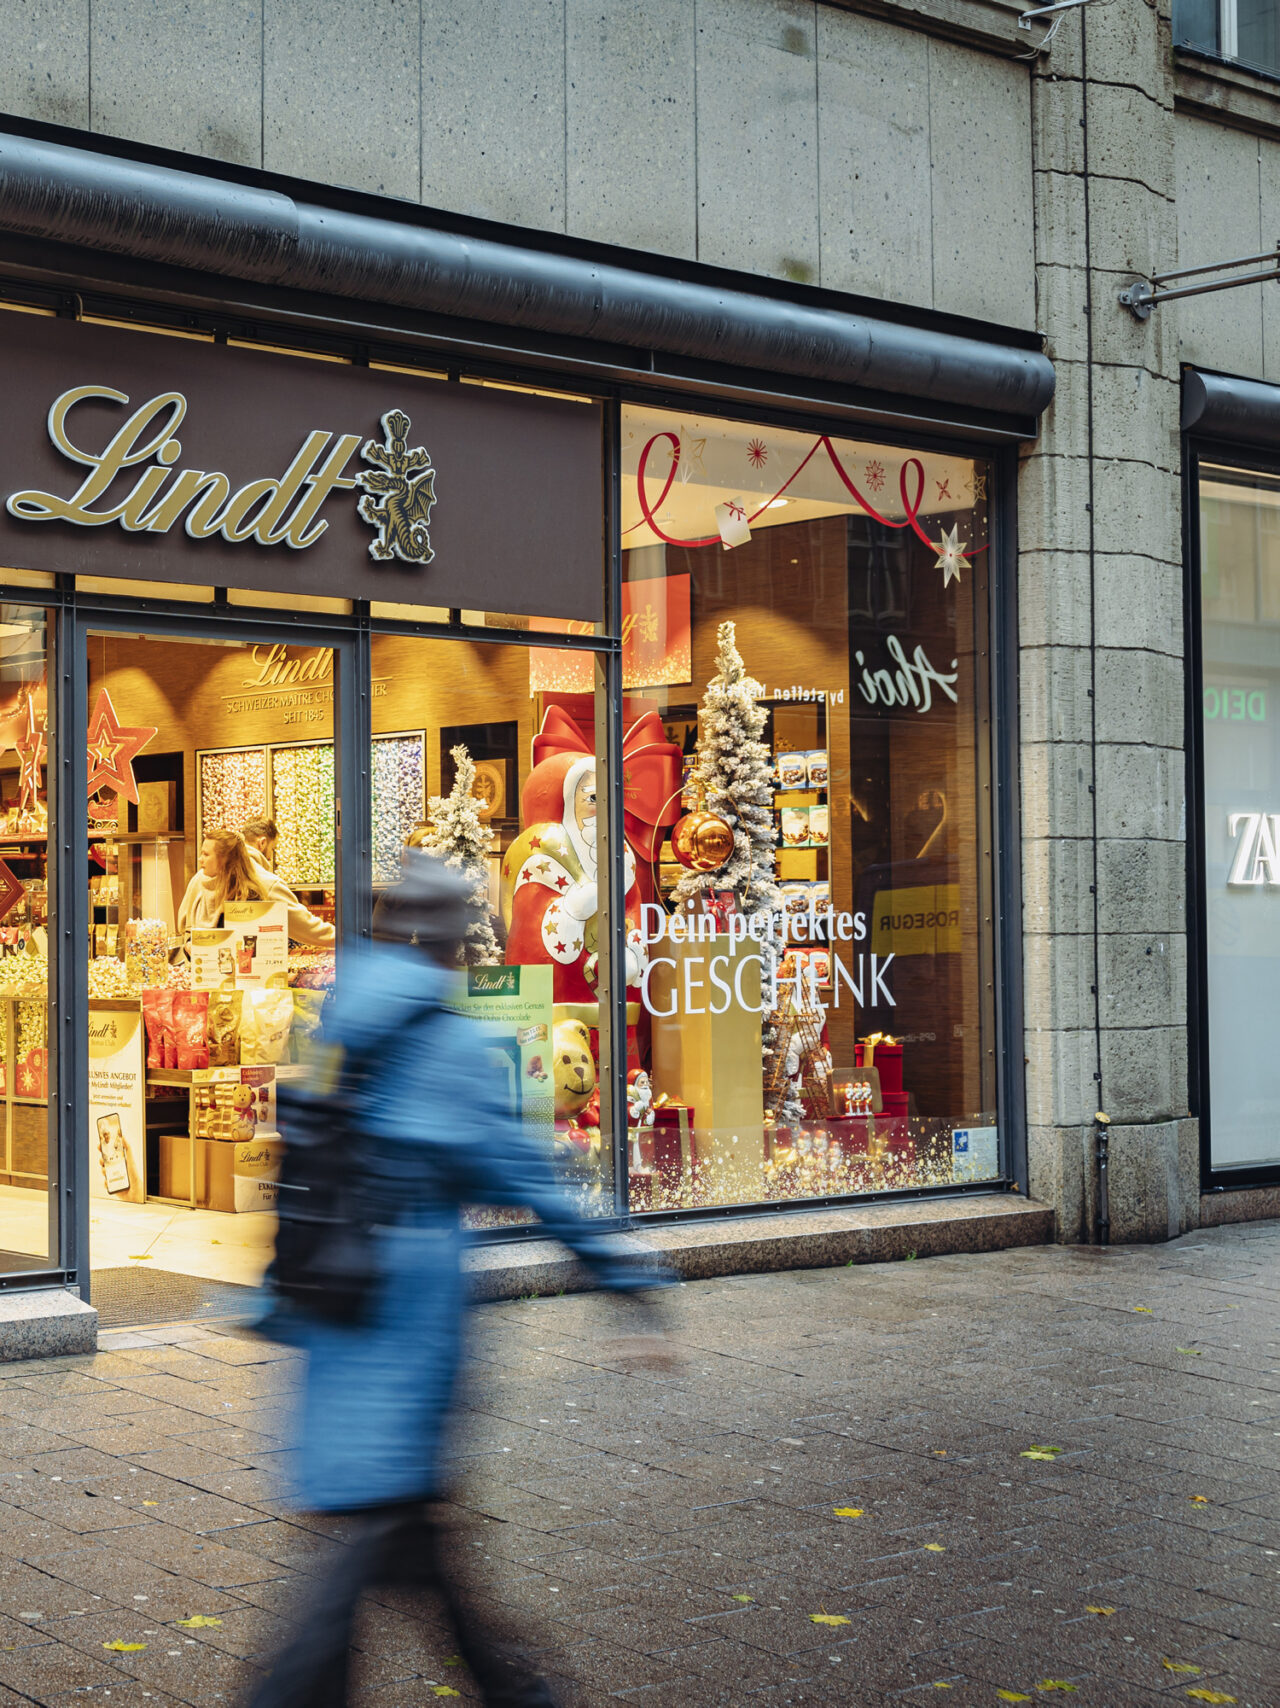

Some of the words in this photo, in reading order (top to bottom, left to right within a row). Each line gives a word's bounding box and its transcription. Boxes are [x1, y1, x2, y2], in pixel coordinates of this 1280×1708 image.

[7, 385, 363, 549] Lindt
[241, 643, 334, 689] Lindt
[226, 692, 278, 714] SCHWEIZER
[284, 711, 302, 725] SEIT
[304, 709, 324, 722] 1845
[640, 900, 718, 944] Dein
[728, 898, 868, 958] perfektes
[472, 973, 507, 990] Lindt
[640, 951, 899, 1018] GESCHENK
[110, 1072, 137, 1082] ANGEBOT
[239, 1150, 264, 1163] Lindt
